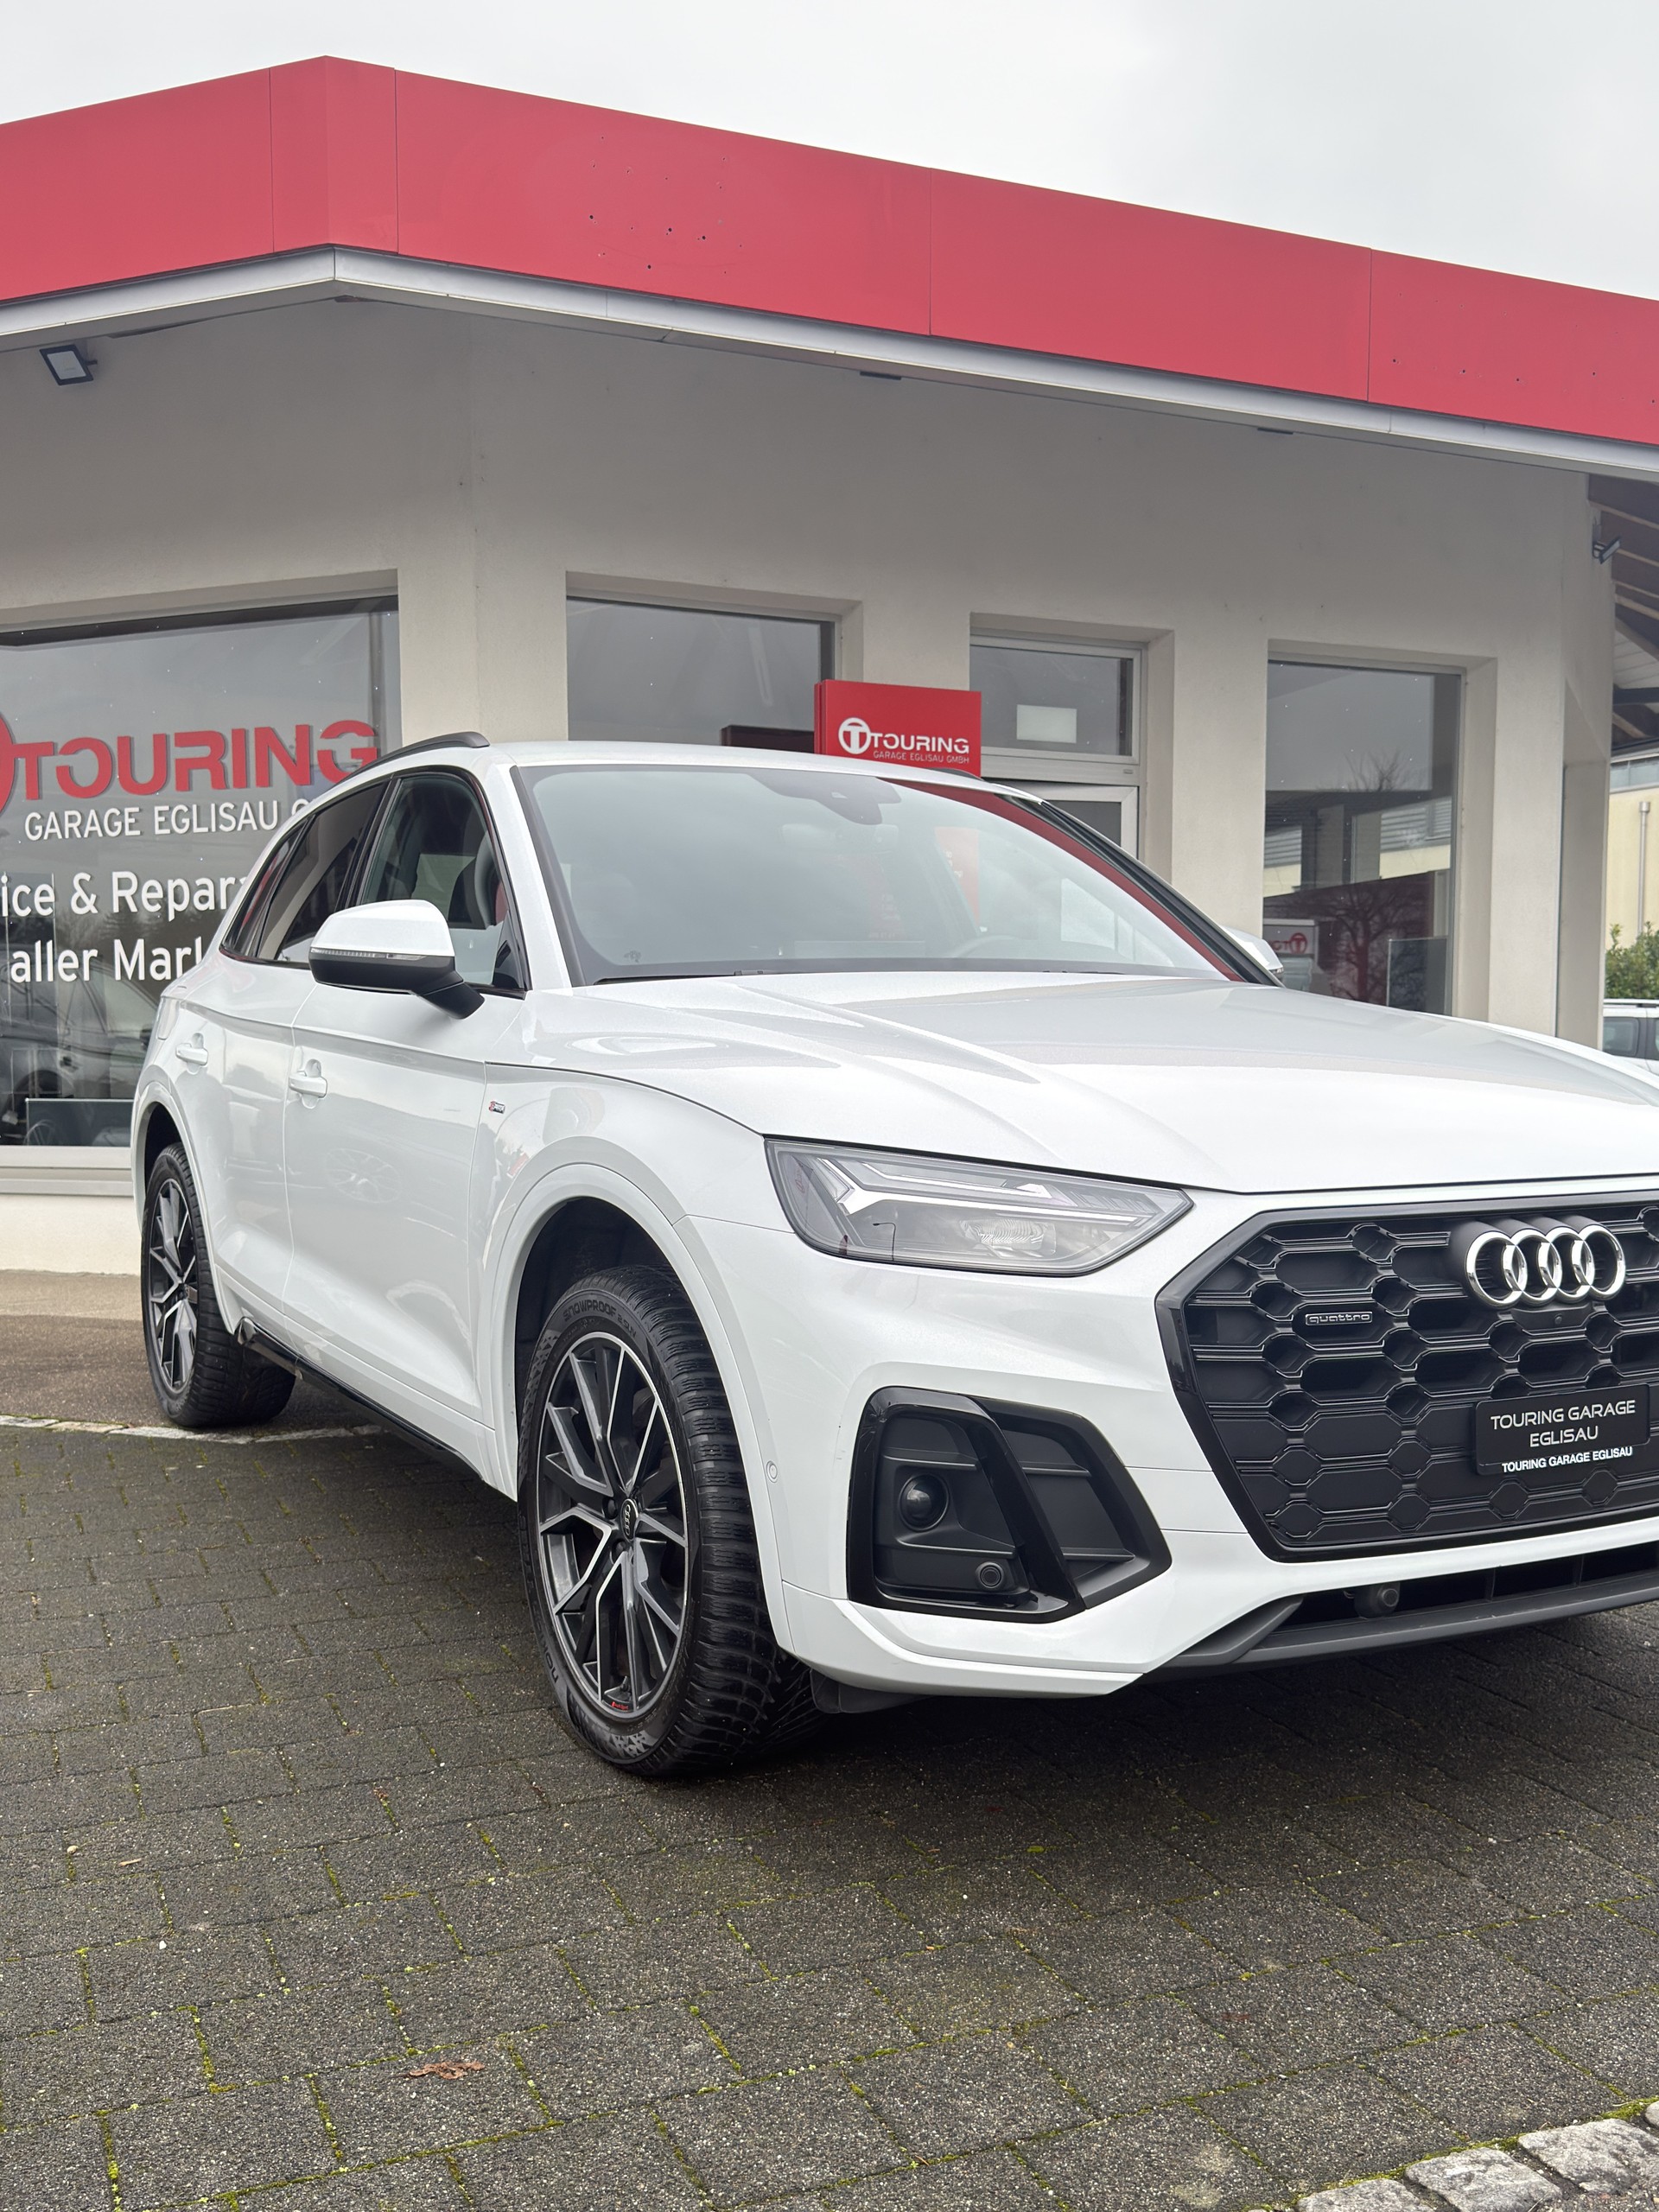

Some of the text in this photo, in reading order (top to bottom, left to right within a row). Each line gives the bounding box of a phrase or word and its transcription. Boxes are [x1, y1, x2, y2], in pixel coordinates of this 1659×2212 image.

[871, 733, 969, 753] TOURING
[874, 750, 906, 760] GARAGE
[910, 753, 944, 762] EGLISAU
[14, 720, 377, 799] TOURING
[25, 807, 141, 841] GARAGE
[154, 800, 278, 835] EGLISAU
[71, 872, 98, 914] &
[112, 870, 247, 921] Repar
[10, 940, 99, 982] aller
[1309, 1313, 1370, 1324] quattro
[1491, 1400, 1636, 1429] TOURING GARAGE
[1530, 1426, 1599, 1447] EGLISAU
[1502, 1446, 1633, 1472] TOURING GARAGE EGLISAU
